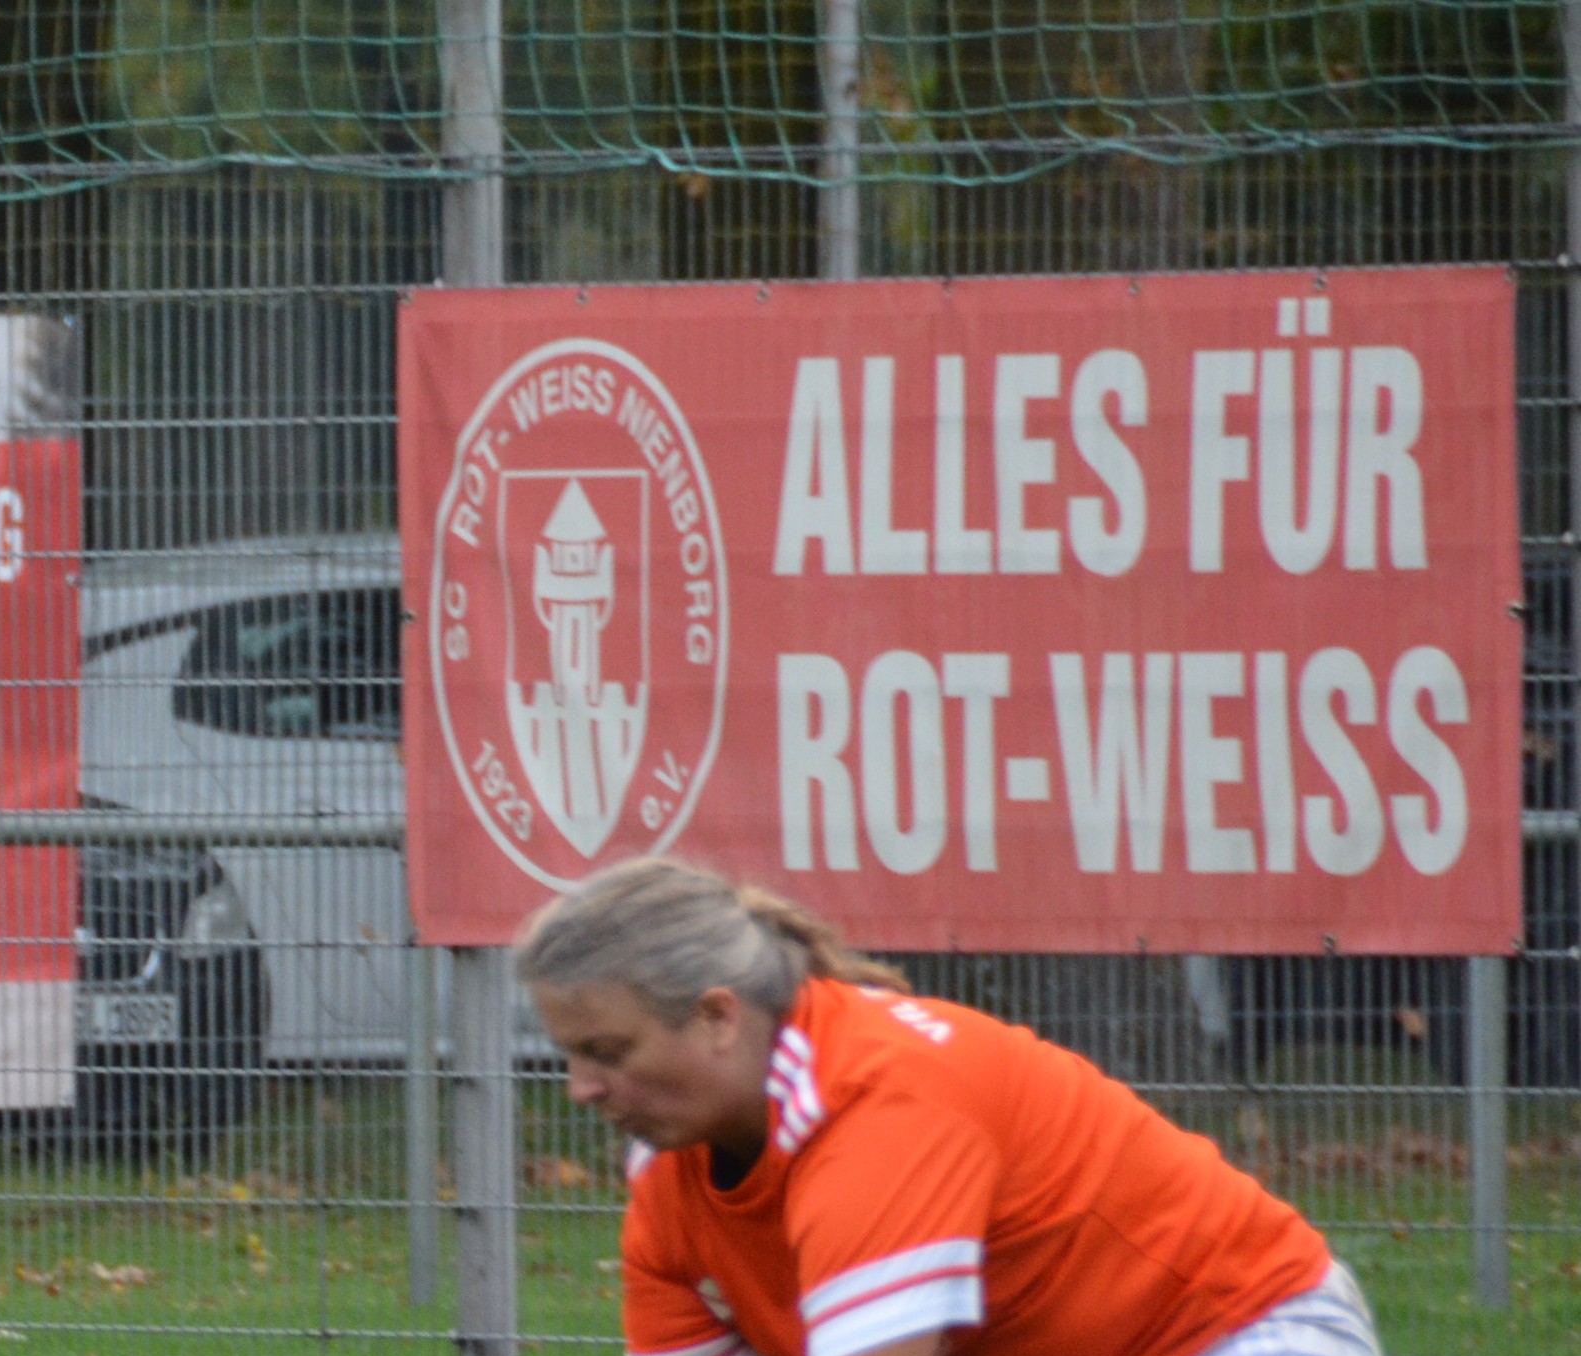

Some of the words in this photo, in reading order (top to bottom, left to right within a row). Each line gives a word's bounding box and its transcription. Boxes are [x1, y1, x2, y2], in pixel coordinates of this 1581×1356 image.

[616, 385, 714, 665] NIENBORG
[772, 347, 1150, 578] ALLES
[1188, 296, 1429, 575] FÜR
[472, 739, 534, 842] 1923
[775, 644, 1471, 877] ROT-WEISS
